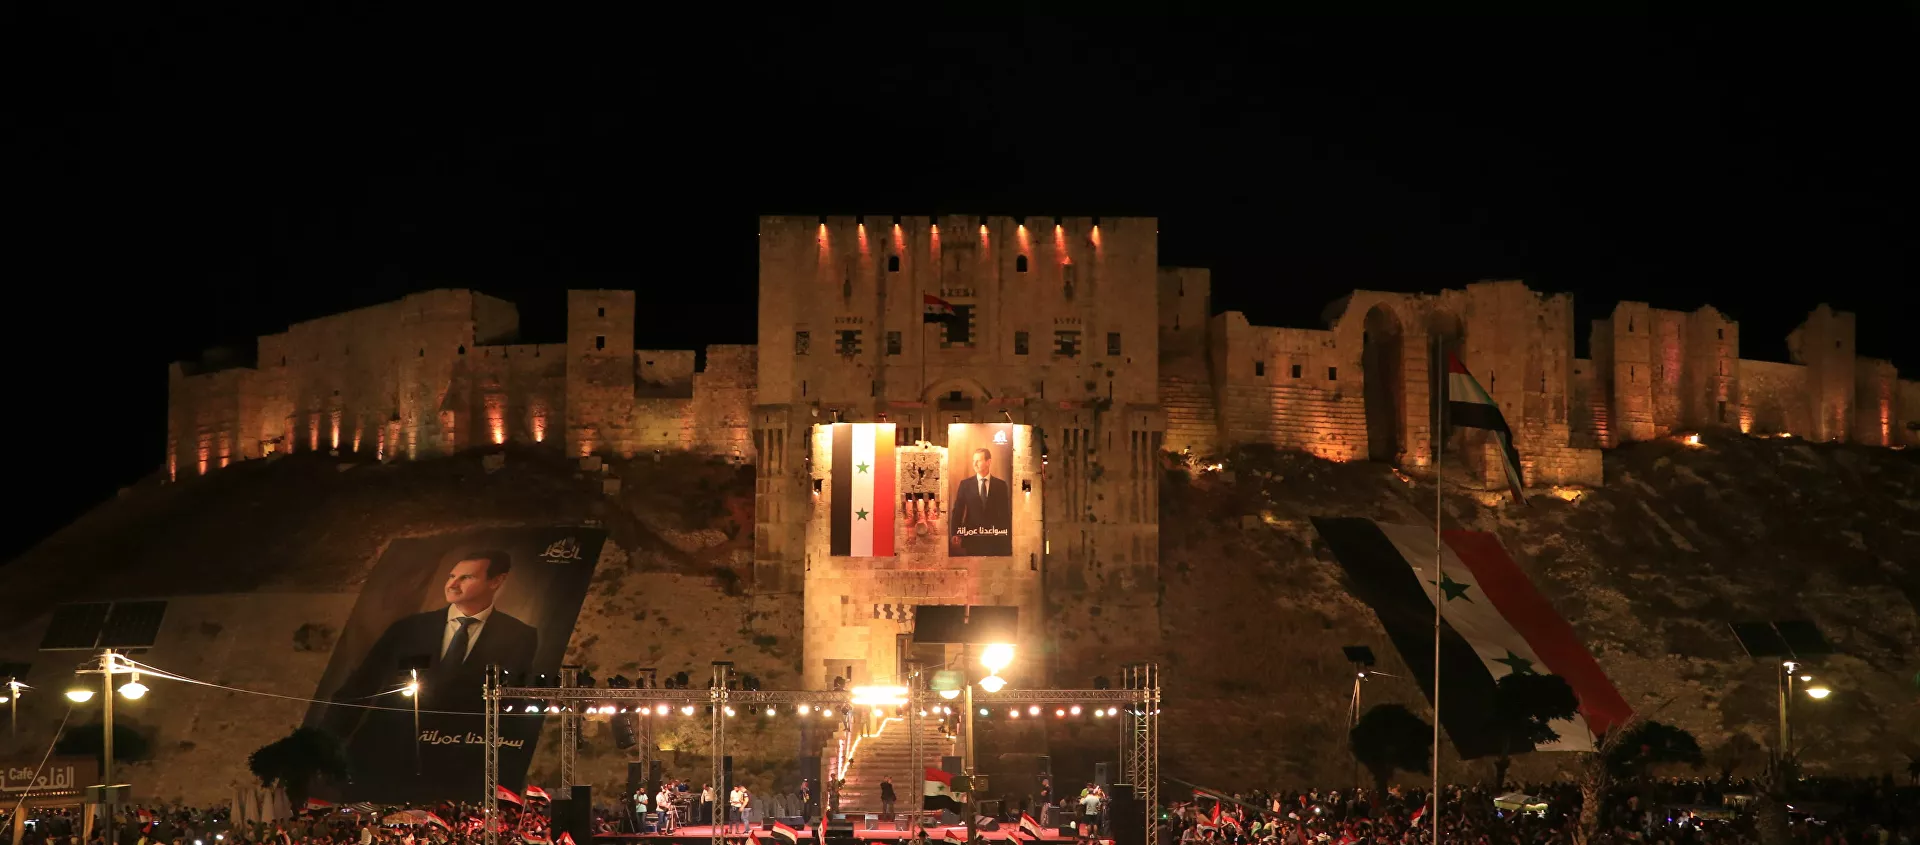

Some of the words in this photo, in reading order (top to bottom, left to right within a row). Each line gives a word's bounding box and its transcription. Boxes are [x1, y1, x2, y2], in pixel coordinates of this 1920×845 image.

[979, 525, 1008, 536] بسواعدنا
[418, 730, 461, 745] عمرانة
[465, 731, 524, 749] بسودنا
